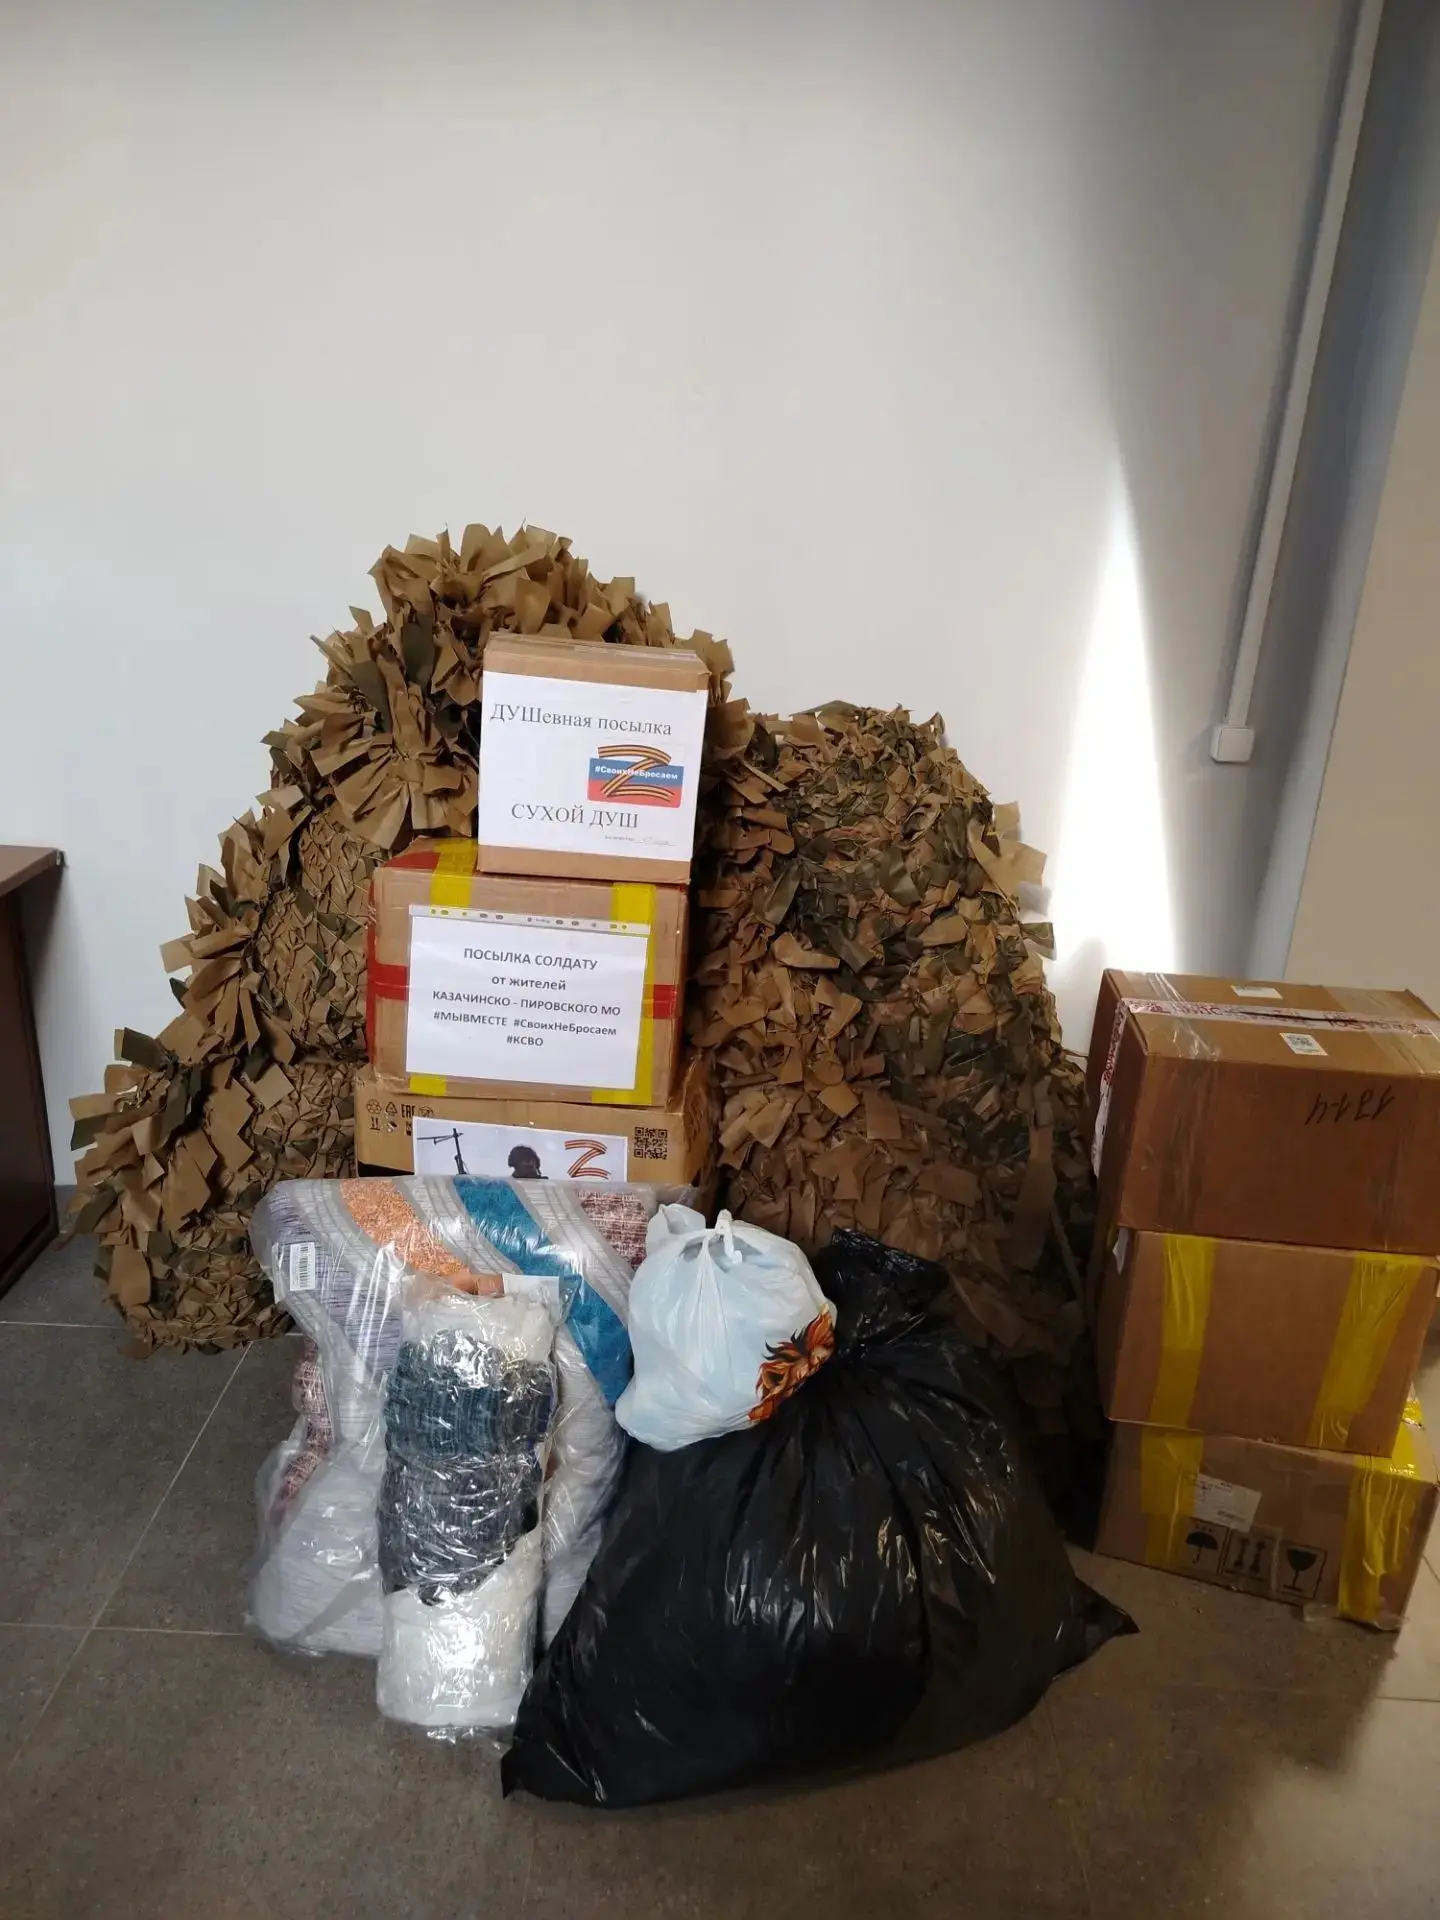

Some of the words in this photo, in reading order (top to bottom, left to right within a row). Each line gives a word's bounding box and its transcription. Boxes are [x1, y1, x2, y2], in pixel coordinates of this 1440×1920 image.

[490, 703, 592, 728] ДУШевная
[598, 717, 672, 735] посылка
[594, 765, 678, 780] #СвоихНеБросаем
[511, 803, 584, 824] СУХОЙ
[588, 809, 638, 829] ДУШ
[463, 947, 531, 964] ПОСЫЛКА
[534, 955, 598, 970] СОЛДАТУ
[491, 976, 506, 985] от
[508, 977, 567, 991] жителей
[432, 990, 511, 1007] КАЗАЧИНСКО
[520, 999, 598, 1014] ПИРОВСКОГО
[601, 1006, 621, 1016] МО
[433, 1011, 508, 1027] #МЫВМЕСТЕ
[513, 1018, 618, 1036] #СвоихНеБросаем
[506, 1035, 544, 1047] #КСВО
